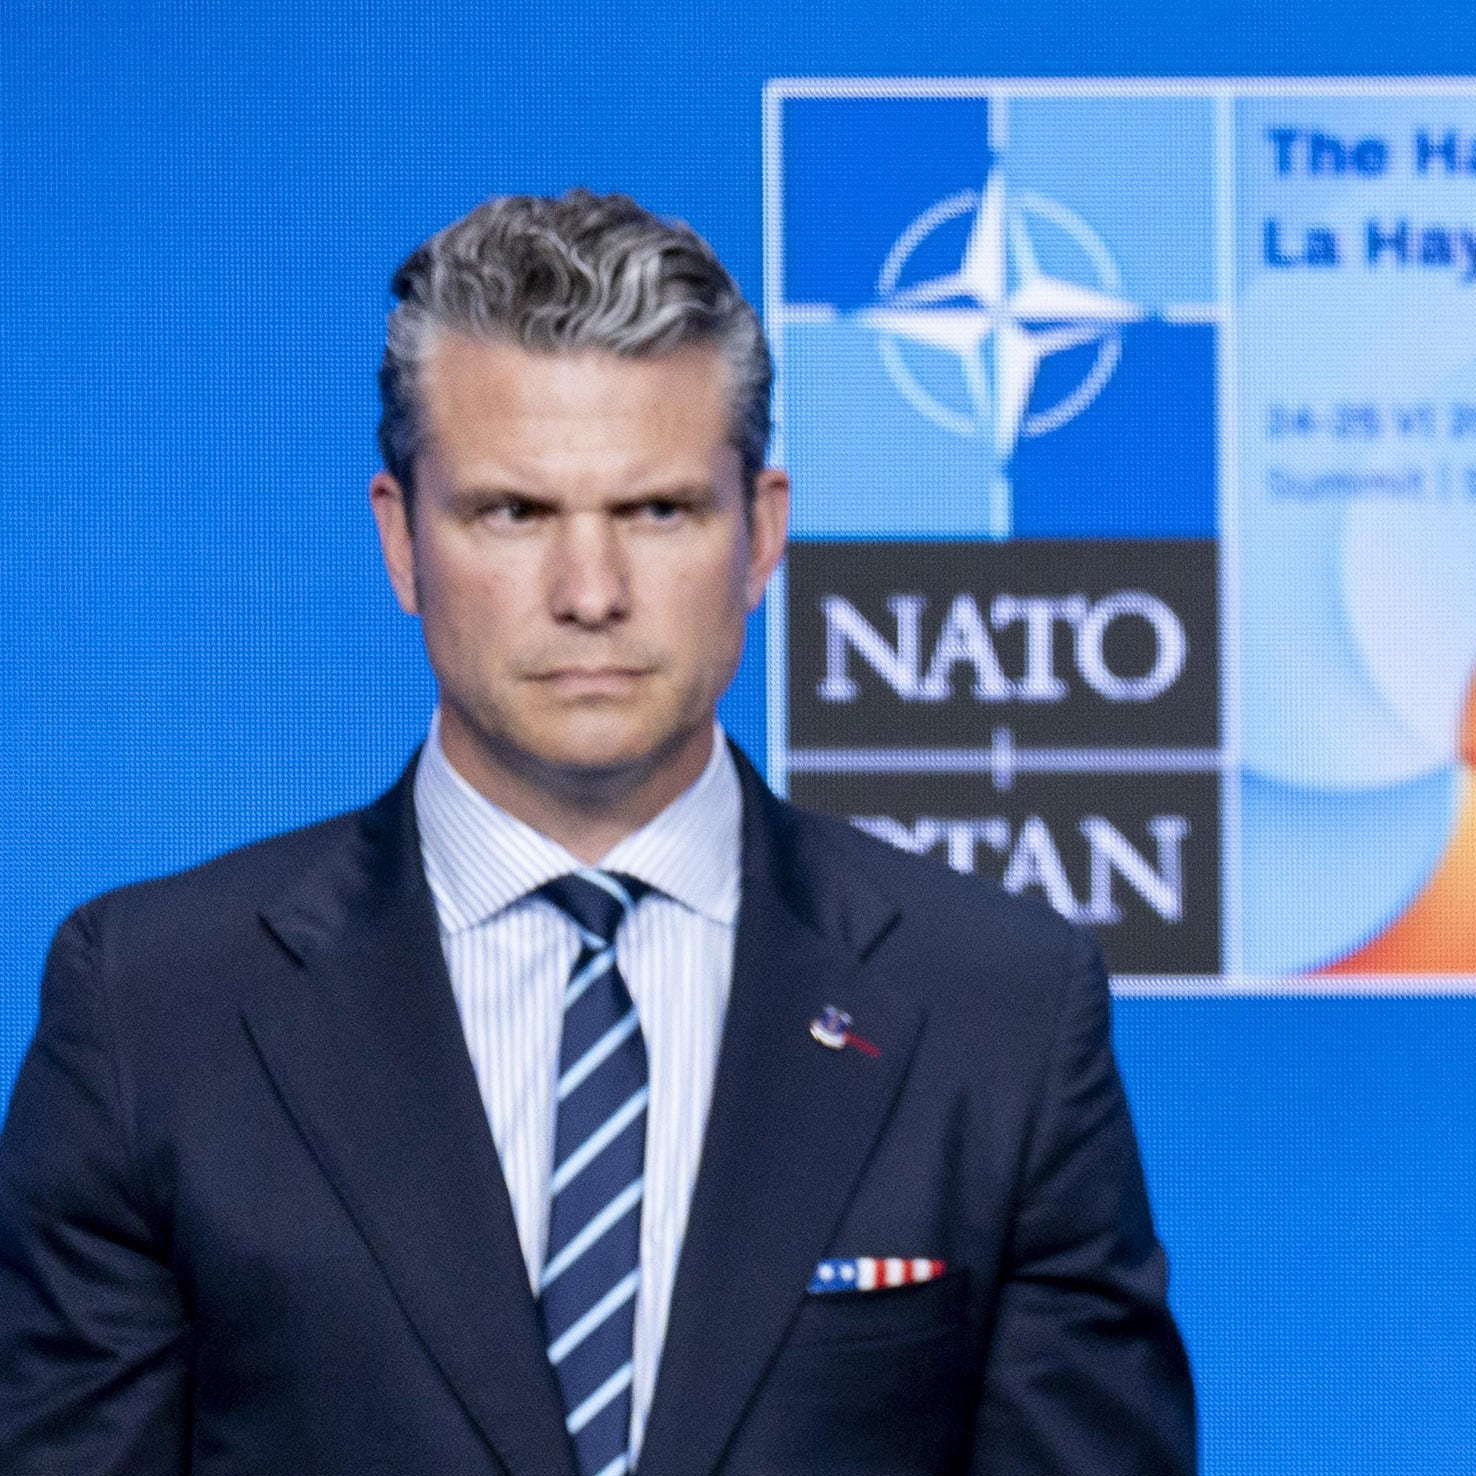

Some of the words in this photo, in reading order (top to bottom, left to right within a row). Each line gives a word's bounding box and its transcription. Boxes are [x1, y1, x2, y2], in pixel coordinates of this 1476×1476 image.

[1266, 124, 1388, 177] The
[1263, 216, 1339, 269] La
[816, 588, 1188, 703] NATO
[848, 815, 1190, 924] TAN
